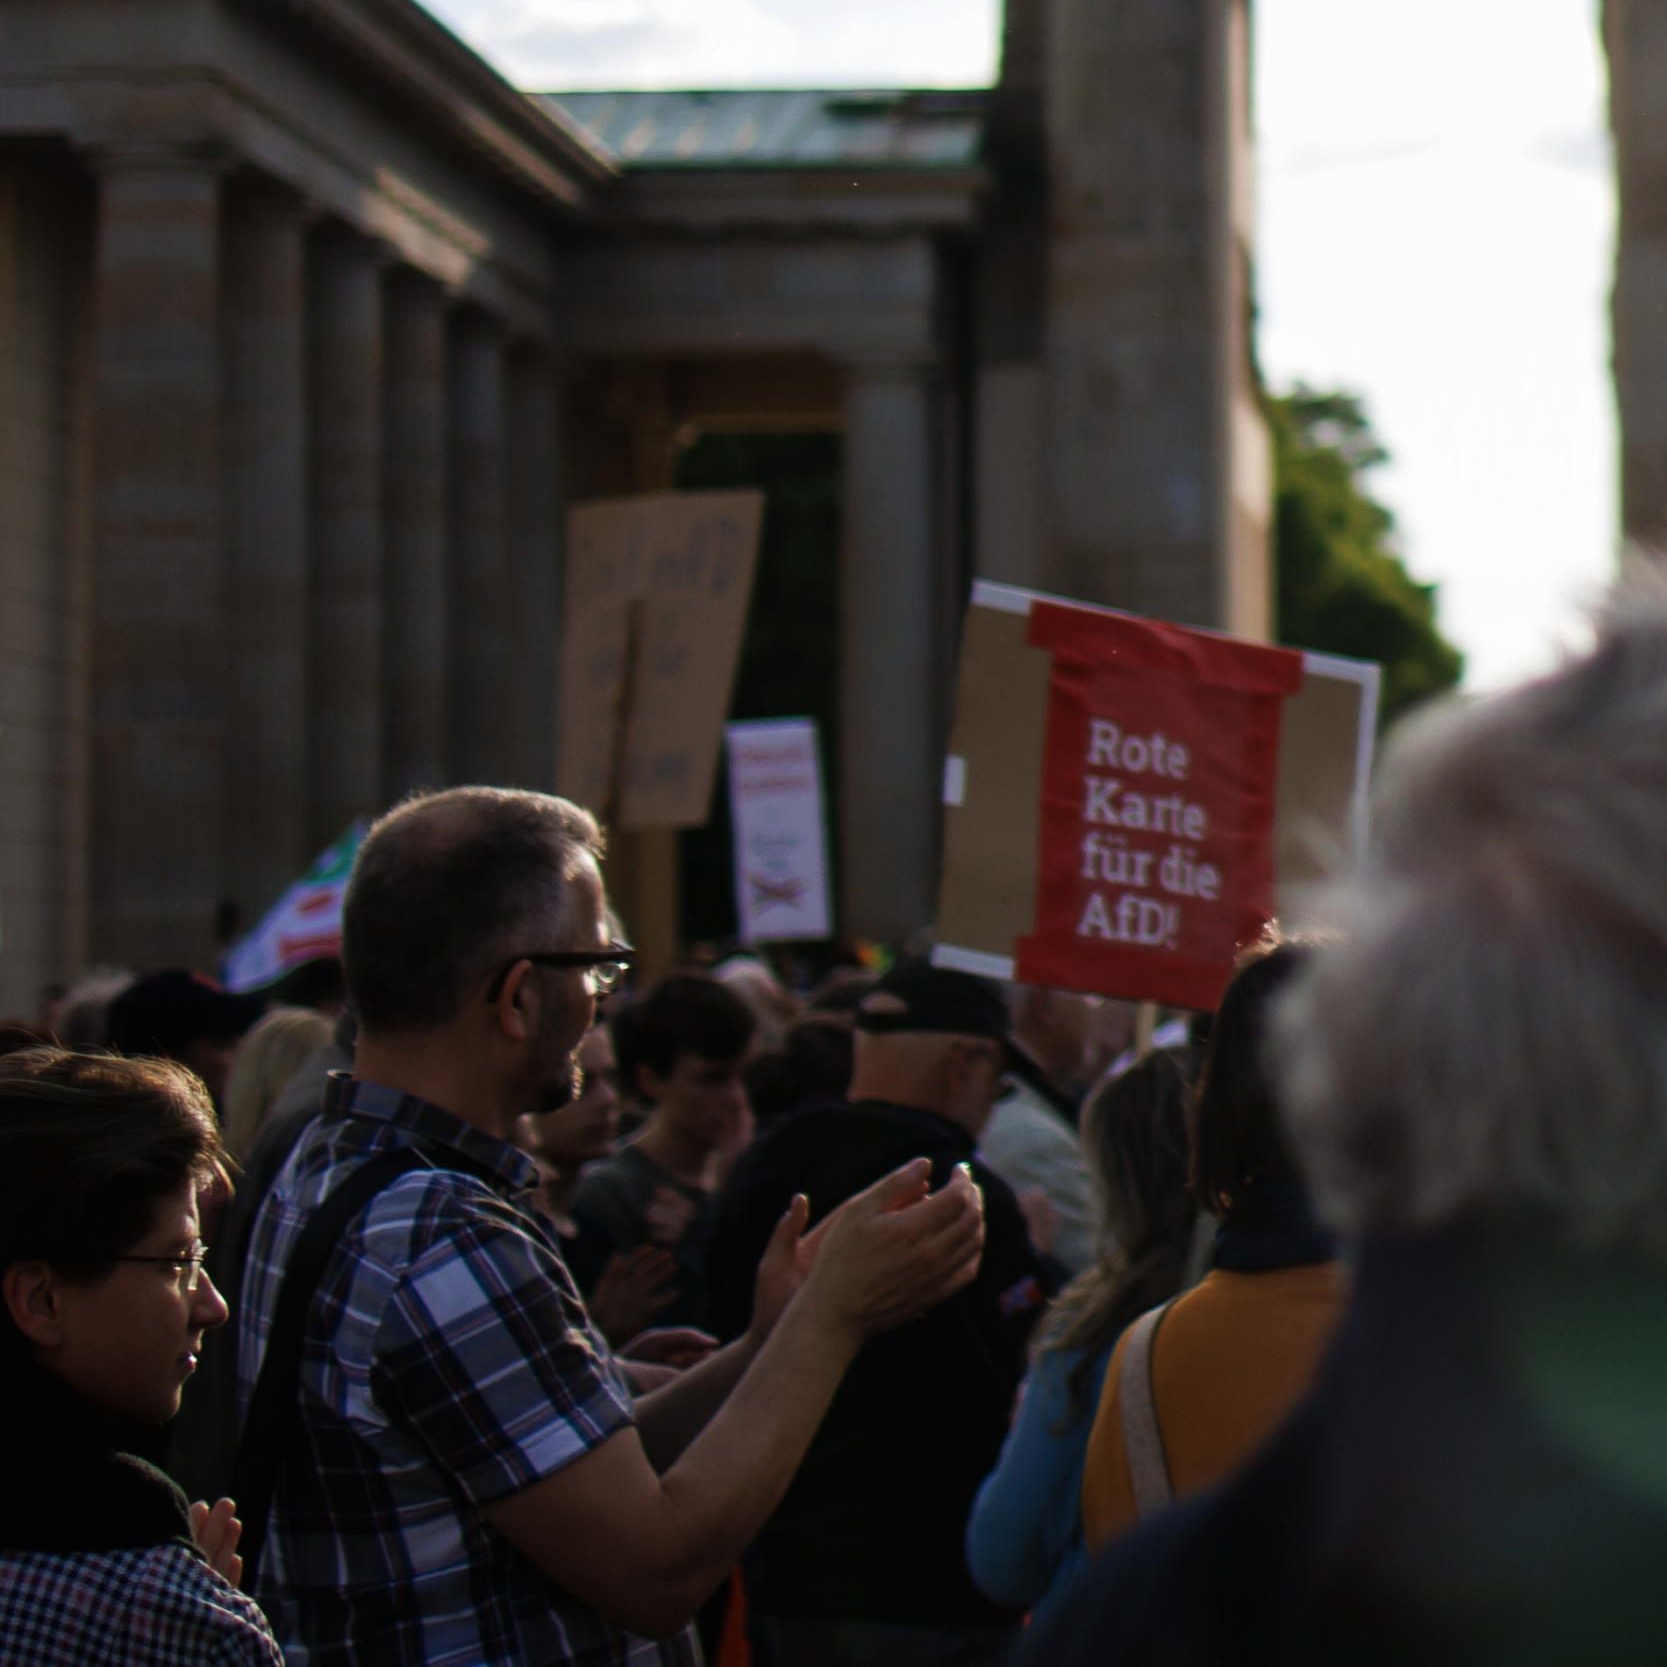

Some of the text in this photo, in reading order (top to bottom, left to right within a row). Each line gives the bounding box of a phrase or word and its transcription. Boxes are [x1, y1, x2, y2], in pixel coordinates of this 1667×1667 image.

[1087, 718, 1189, 780] Rote
[1083, 775, 1207, 841] Karte
[1080, 832, 1221, 901] für die
[1077, 891, 1178, 950] AfD!
